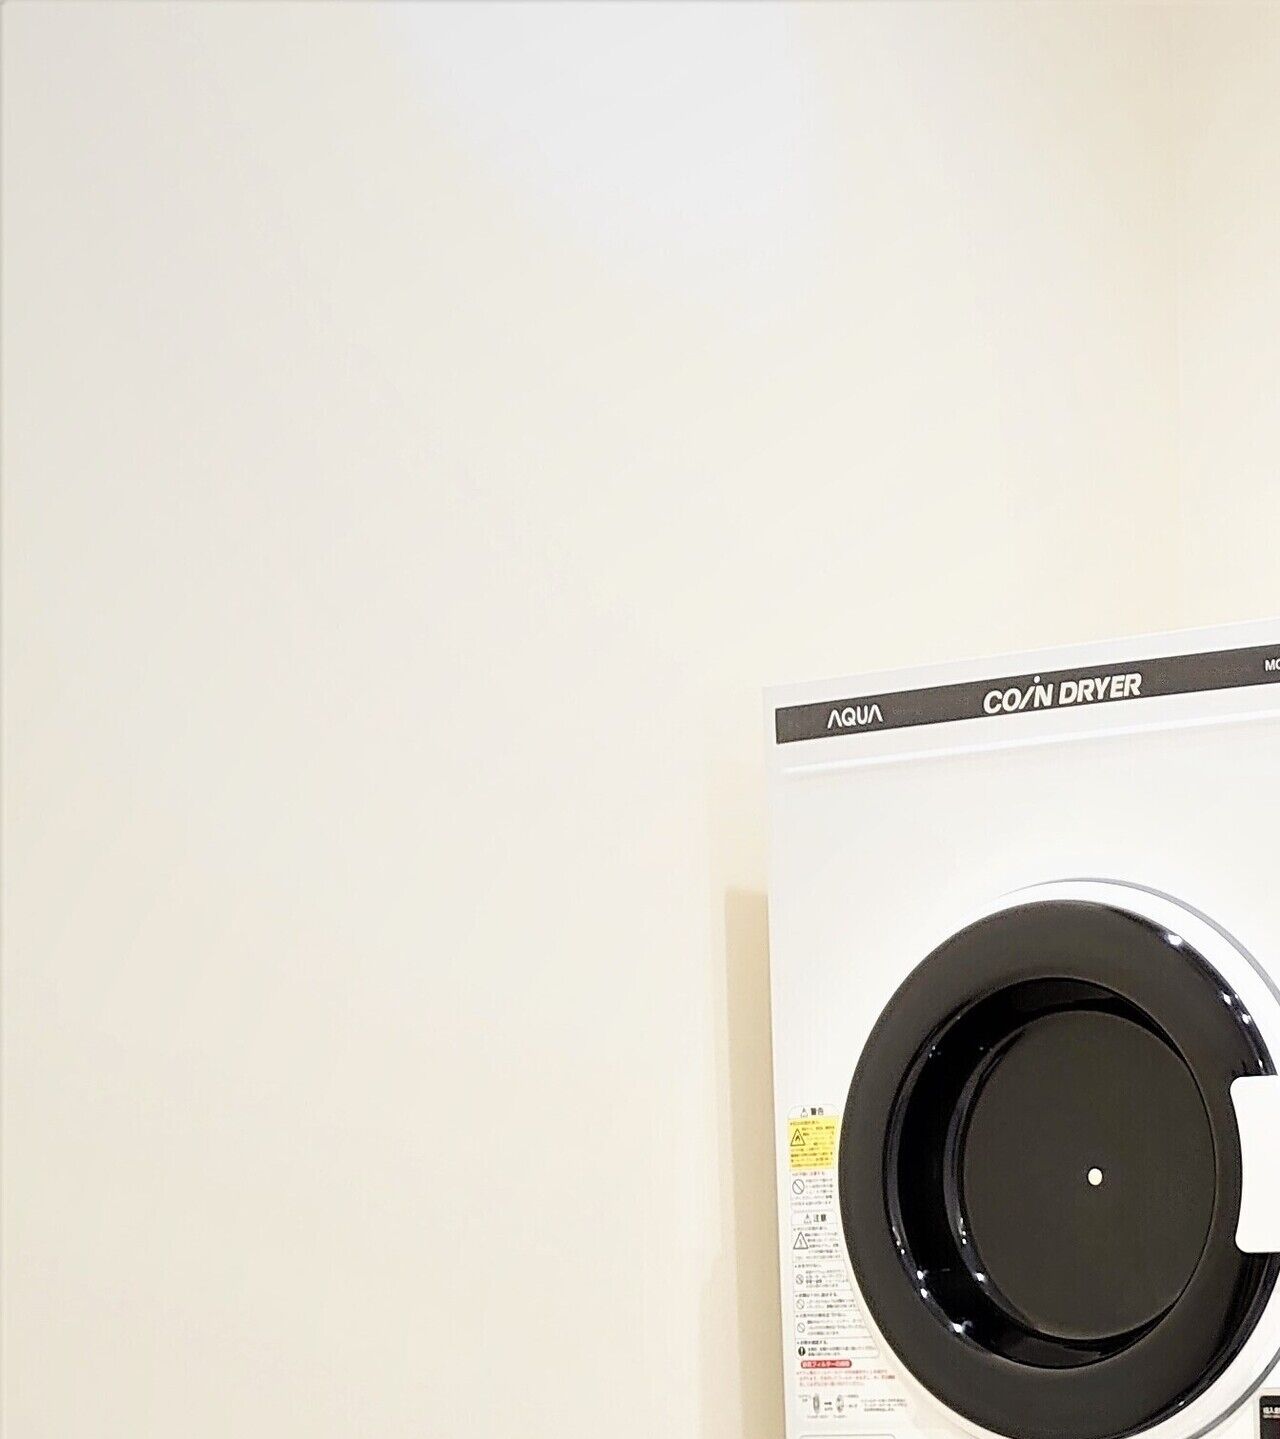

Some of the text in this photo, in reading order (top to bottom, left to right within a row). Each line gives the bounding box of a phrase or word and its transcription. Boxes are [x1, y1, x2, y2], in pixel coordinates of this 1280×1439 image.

[983, 673, 1142, 715] COIN DRYER
[827, 704, 883, 729] AQUA
